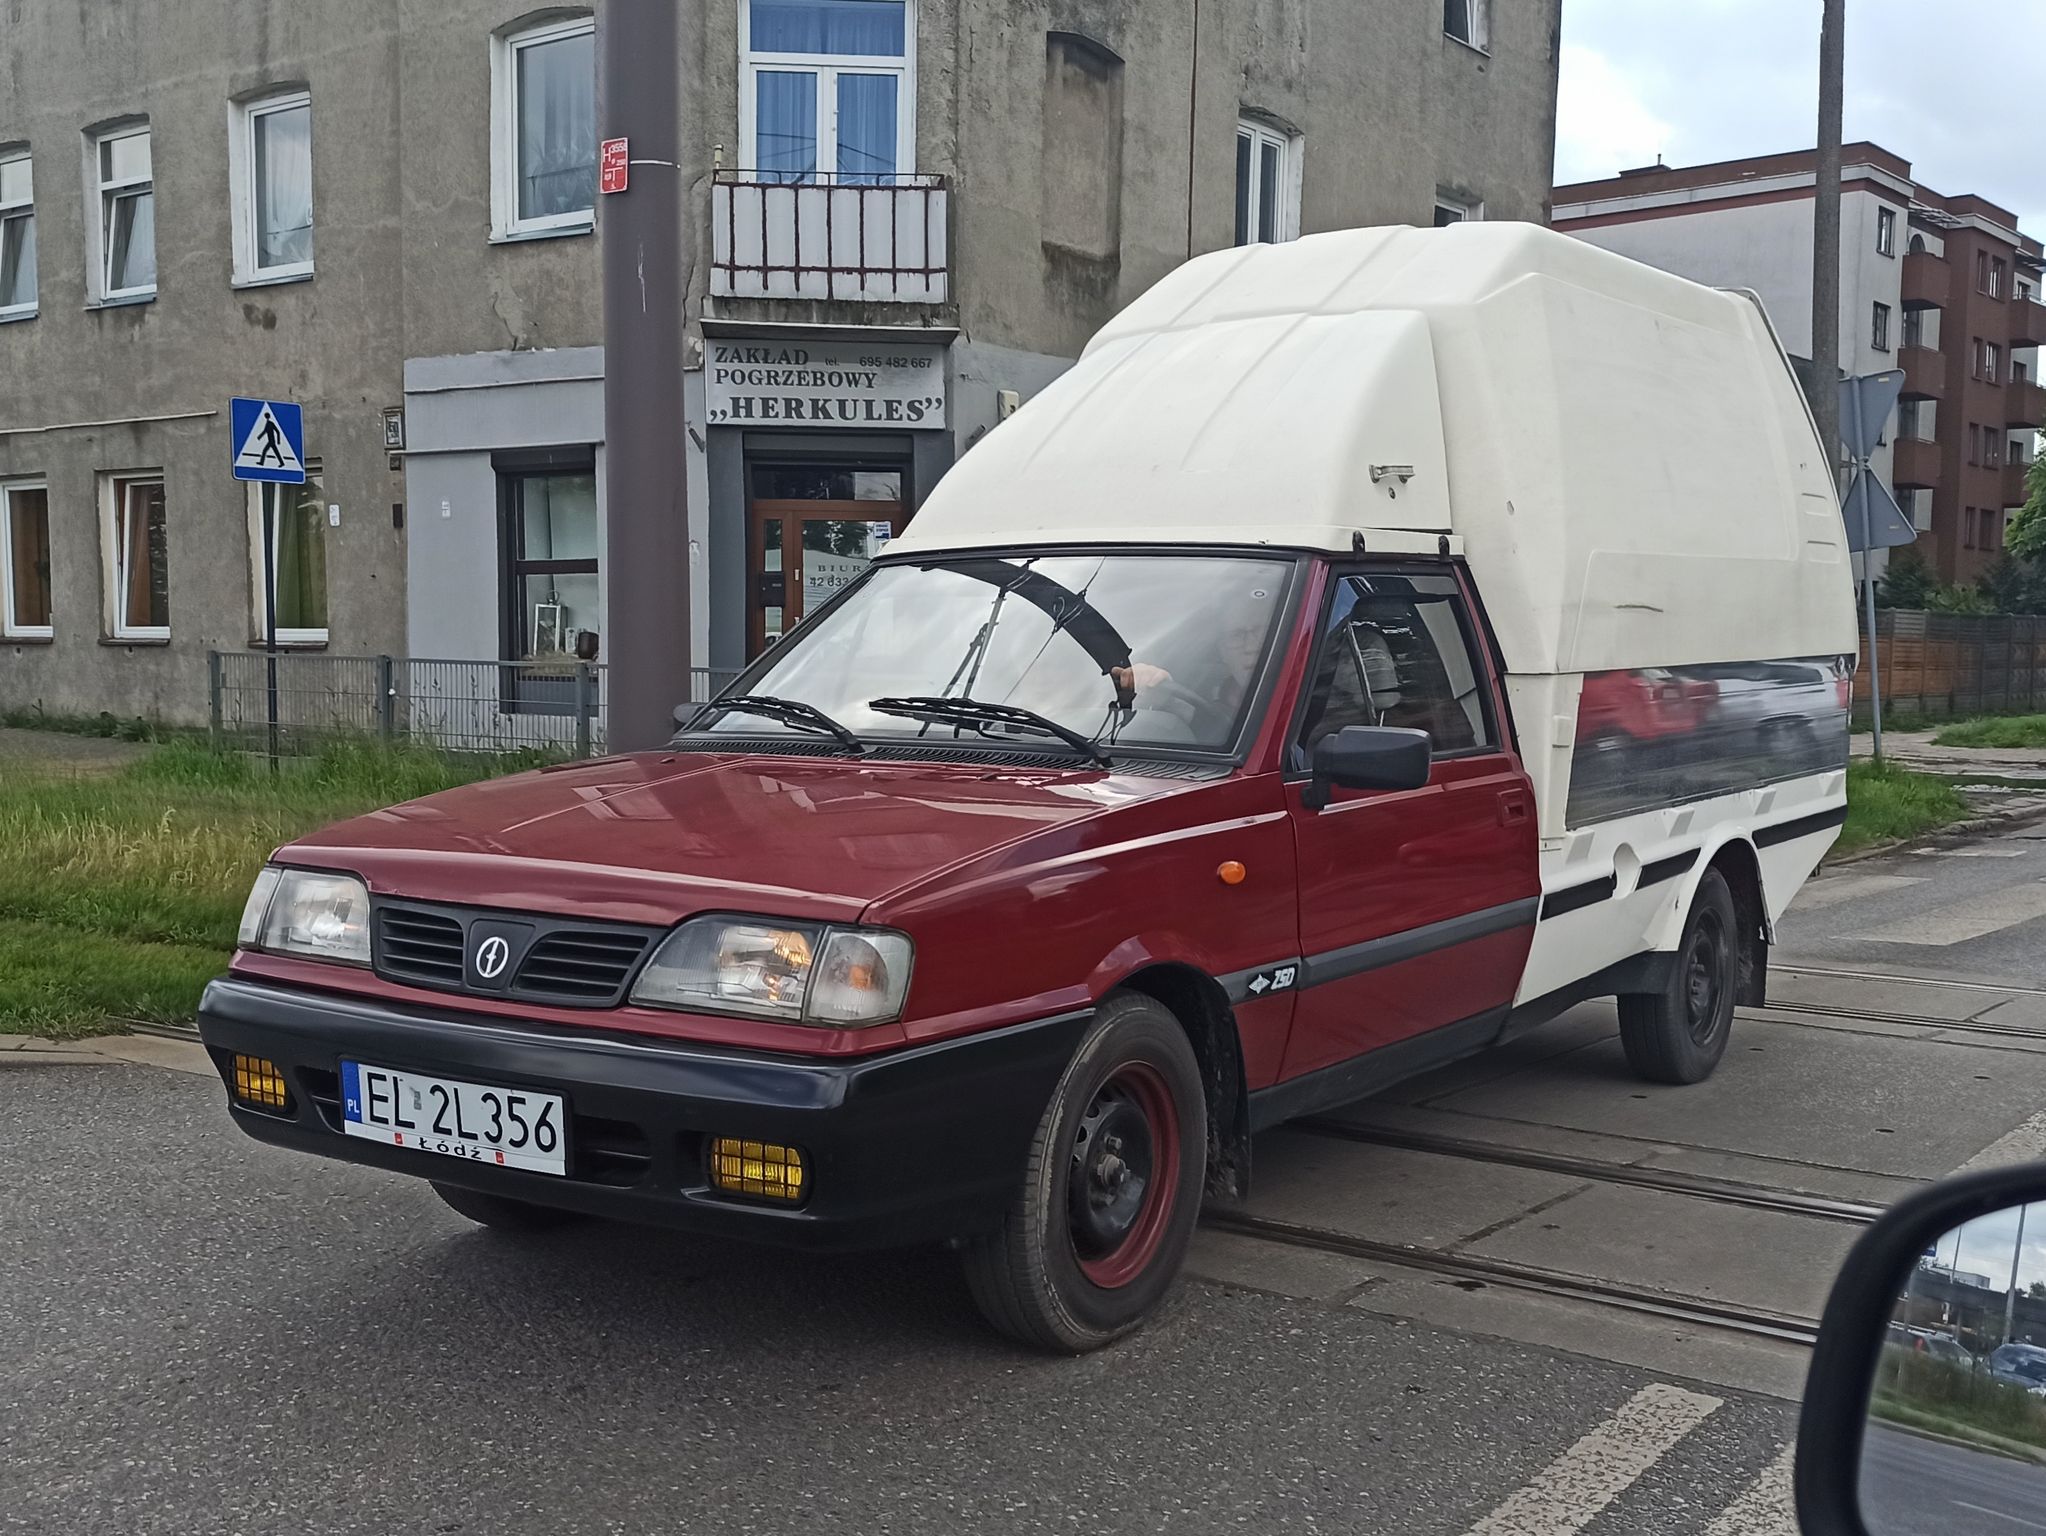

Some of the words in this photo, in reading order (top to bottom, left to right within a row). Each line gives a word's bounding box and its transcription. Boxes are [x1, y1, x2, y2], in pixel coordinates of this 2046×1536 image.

[715, 347, 809, 365] ZAKŁAD
[824, 356, 841, 367] tel.
[859, 357, 882, 368] 695
[885, 357, 908, 369] 482
[910, 357, 932, 369] 667
[715, 368, 878, 389] POGRZEBOWY
[817, 564, 870, 573] BIUR
[809, 577, 824, 587] 42
[347, 1099, 360, 1114] PL
[367, 1071, 415, 1129] EL
[429, 1084, 557, 1153] 2L356
[418, 1136, 482, 1160] Łódź
